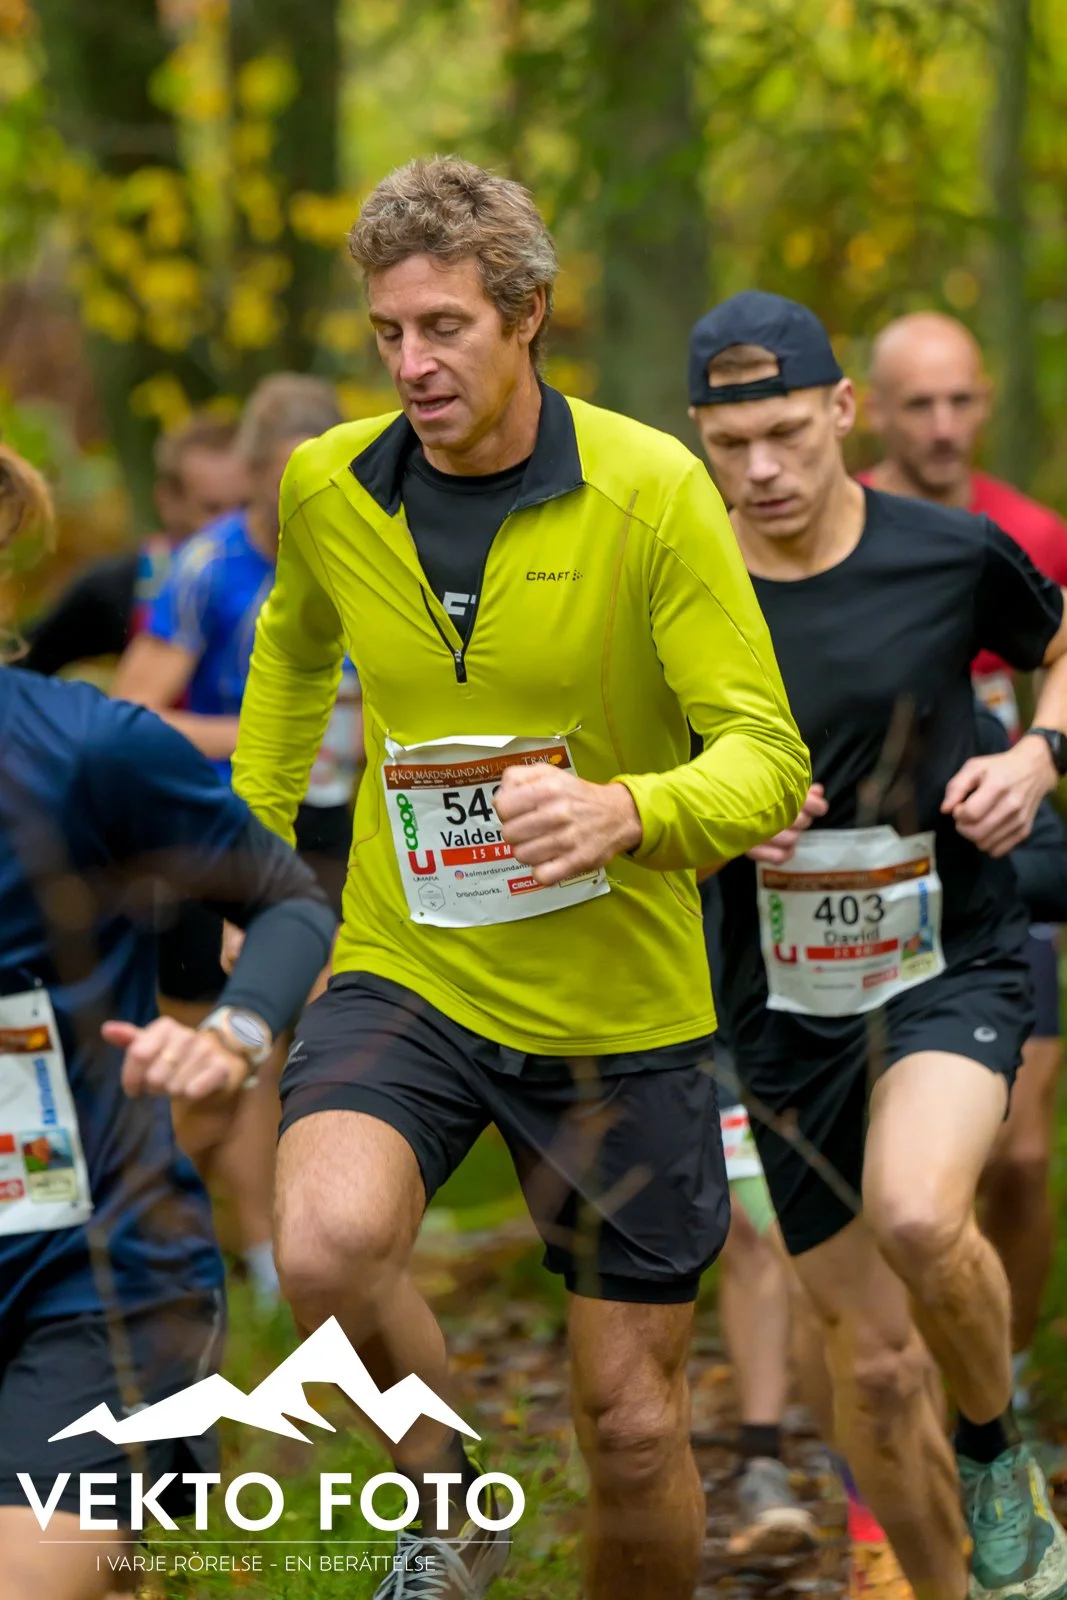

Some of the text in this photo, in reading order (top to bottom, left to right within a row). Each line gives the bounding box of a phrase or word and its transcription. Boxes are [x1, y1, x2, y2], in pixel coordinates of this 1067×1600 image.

[526, 571, 570, 581] CRAFT
[396, 793, 418, 850] coop
[442, 785, 502, 826] 54
[472, 844, 511, 860] 15 KM
[814, 894, 885, 926] 403
